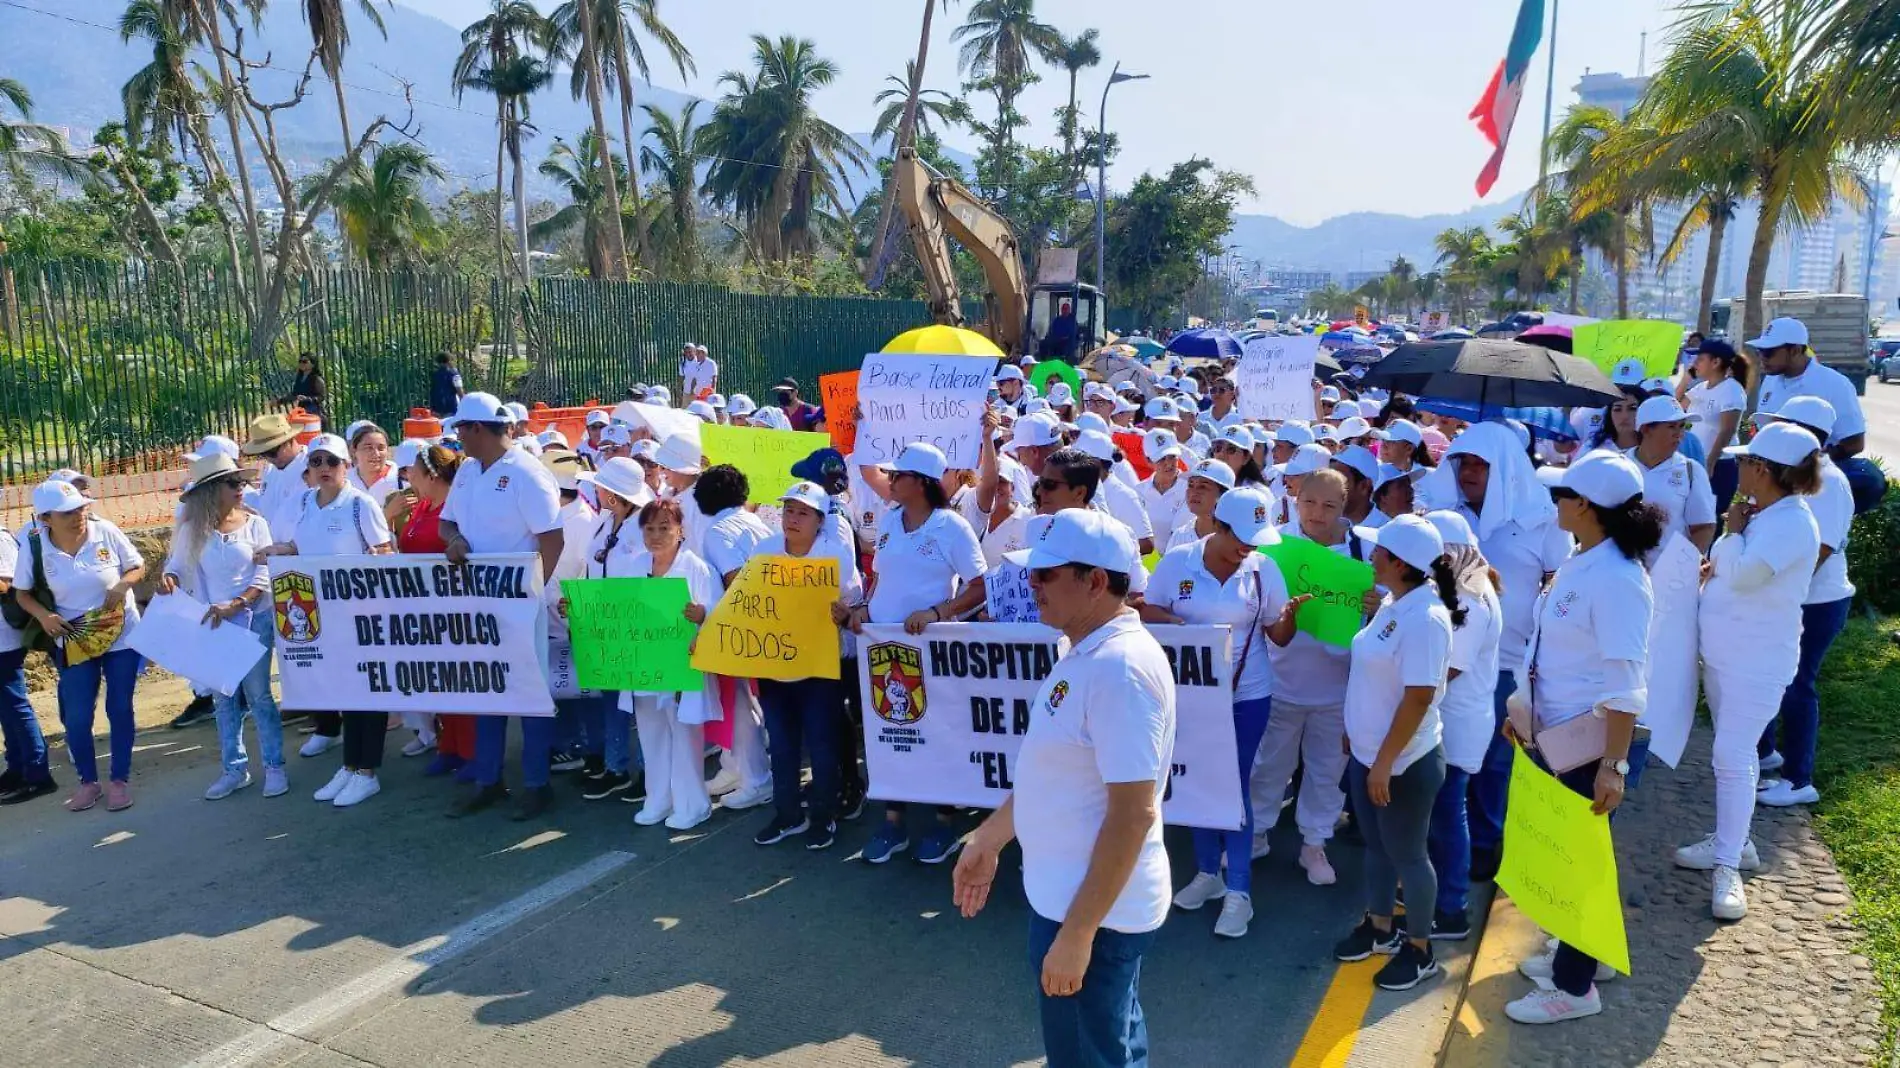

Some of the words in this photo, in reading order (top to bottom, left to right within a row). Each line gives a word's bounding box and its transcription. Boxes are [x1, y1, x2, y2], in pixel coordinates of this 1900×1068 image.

[861, 362, 921, 389] Base
[928, 362, 989, 390] Federal
[919, 393, 969, 420] todos
[274, 574, 313, 594] SNTSA
[319, 567, 430, 600] HOSPITAL
[431, 563, 528, 599] GENERAL
[761, 563, 839, 588] FEDERAL
[730, 589, 780, 621] PARA
[354, 614, 385, 646] DE
[389, 612, 501, 646] ACAPULCO
[716, 622, 798, 661] TODOS
[871, 646, 917, 665] SNTSA
[929, 640, 1059, 681] HOSPITA
[970, 696, 1007, 735] DE
